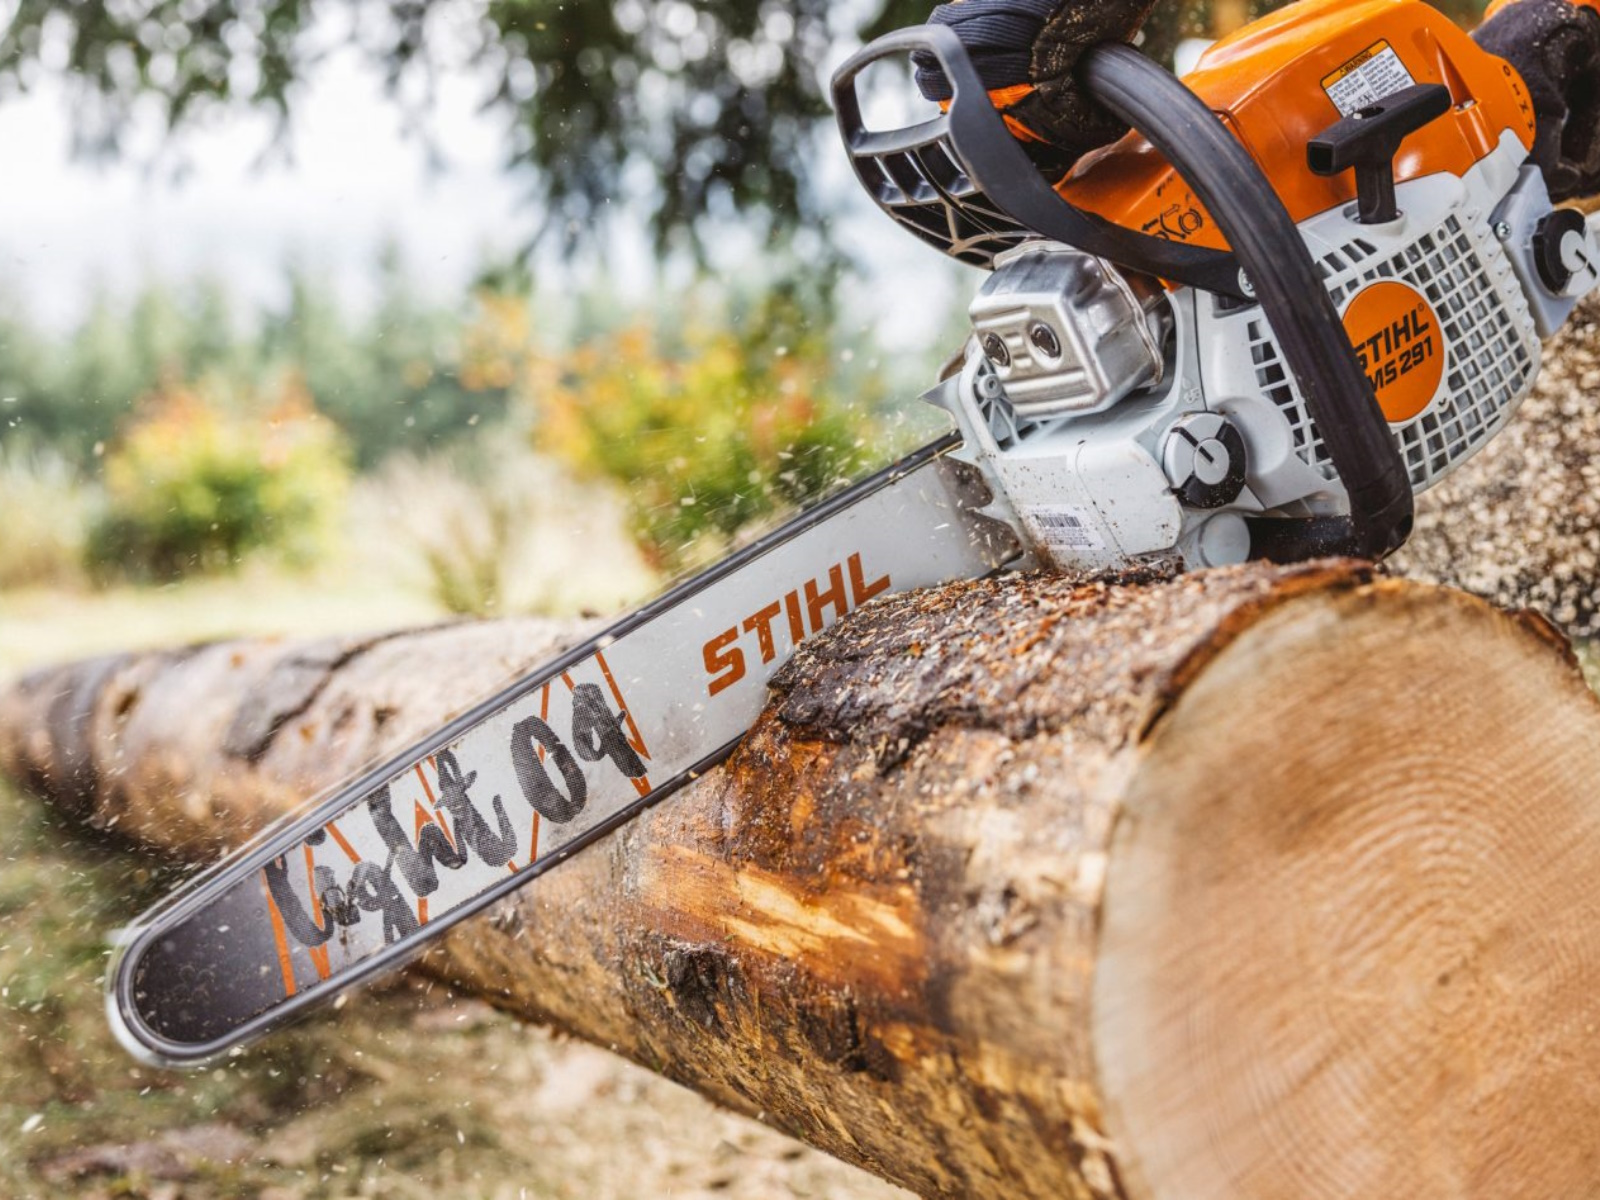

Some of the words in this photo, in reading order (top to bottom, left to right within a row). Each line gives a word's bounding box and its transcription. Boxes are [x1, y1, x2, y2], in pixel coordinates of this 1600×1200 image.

[1354, 308, 1430, 371] STIHL
[1367, 359, 1398, 393] MS
[1399, 335, 1433, 376] 291
[702, 551, 891, 697] STIHL
[510, 682, 648, 823] 04
